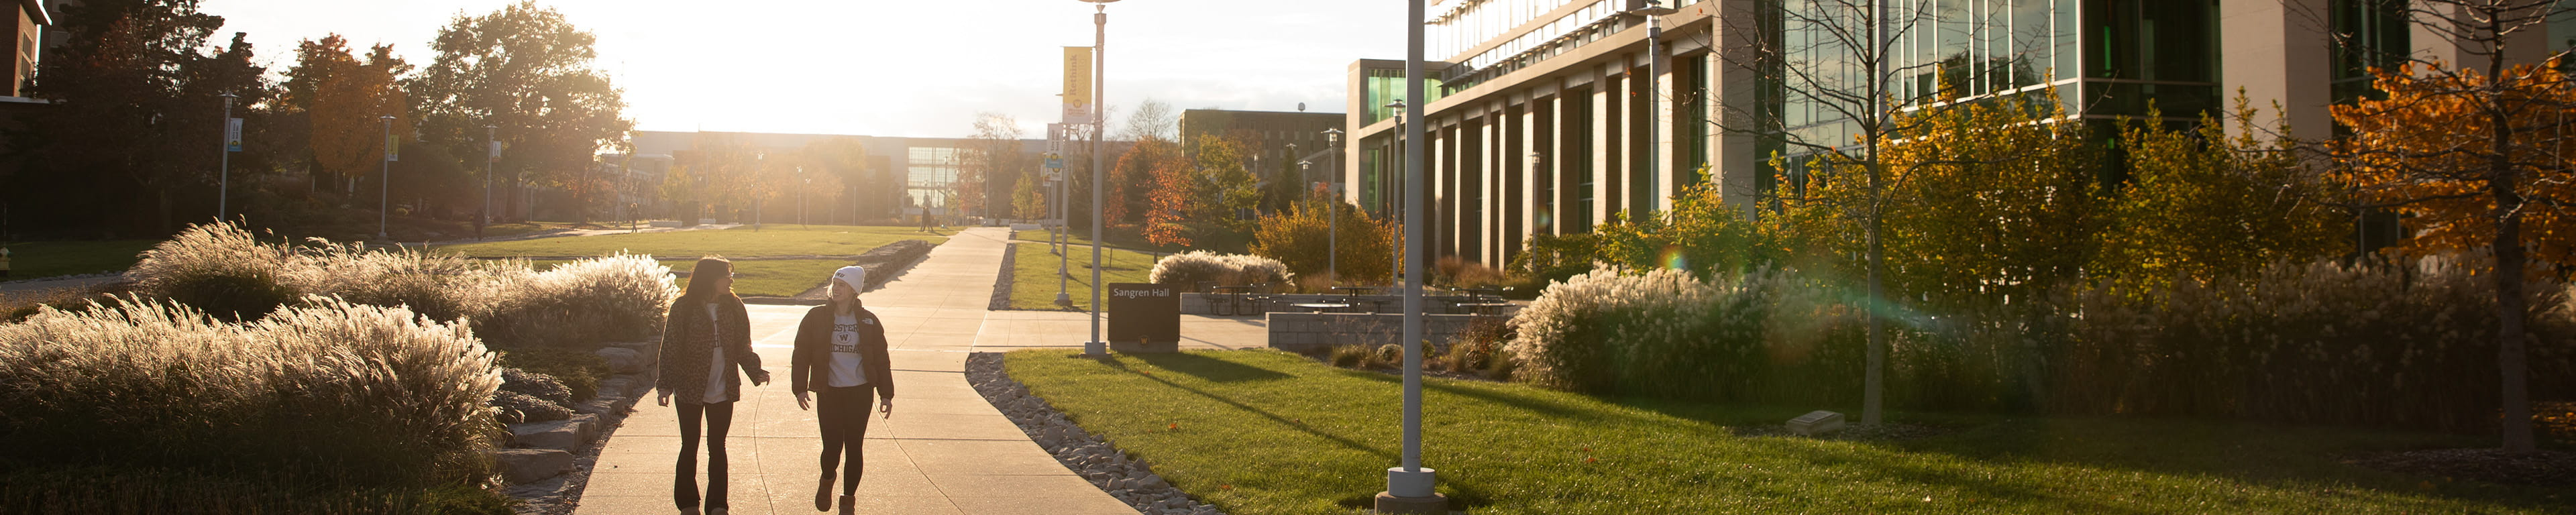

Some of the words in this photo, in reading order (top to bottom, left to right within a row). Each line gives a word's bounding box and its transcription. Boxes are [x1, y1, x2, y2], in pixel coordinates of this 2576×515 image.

[1069, 54, 1077, 96] Rethink
[1114, 288, 1149, 299] Sangren
[1152, 288, 1169, 297] Hall
[833, 323, 859, 333] ESTER
[831, 343, 859, 354] ICHIGA
